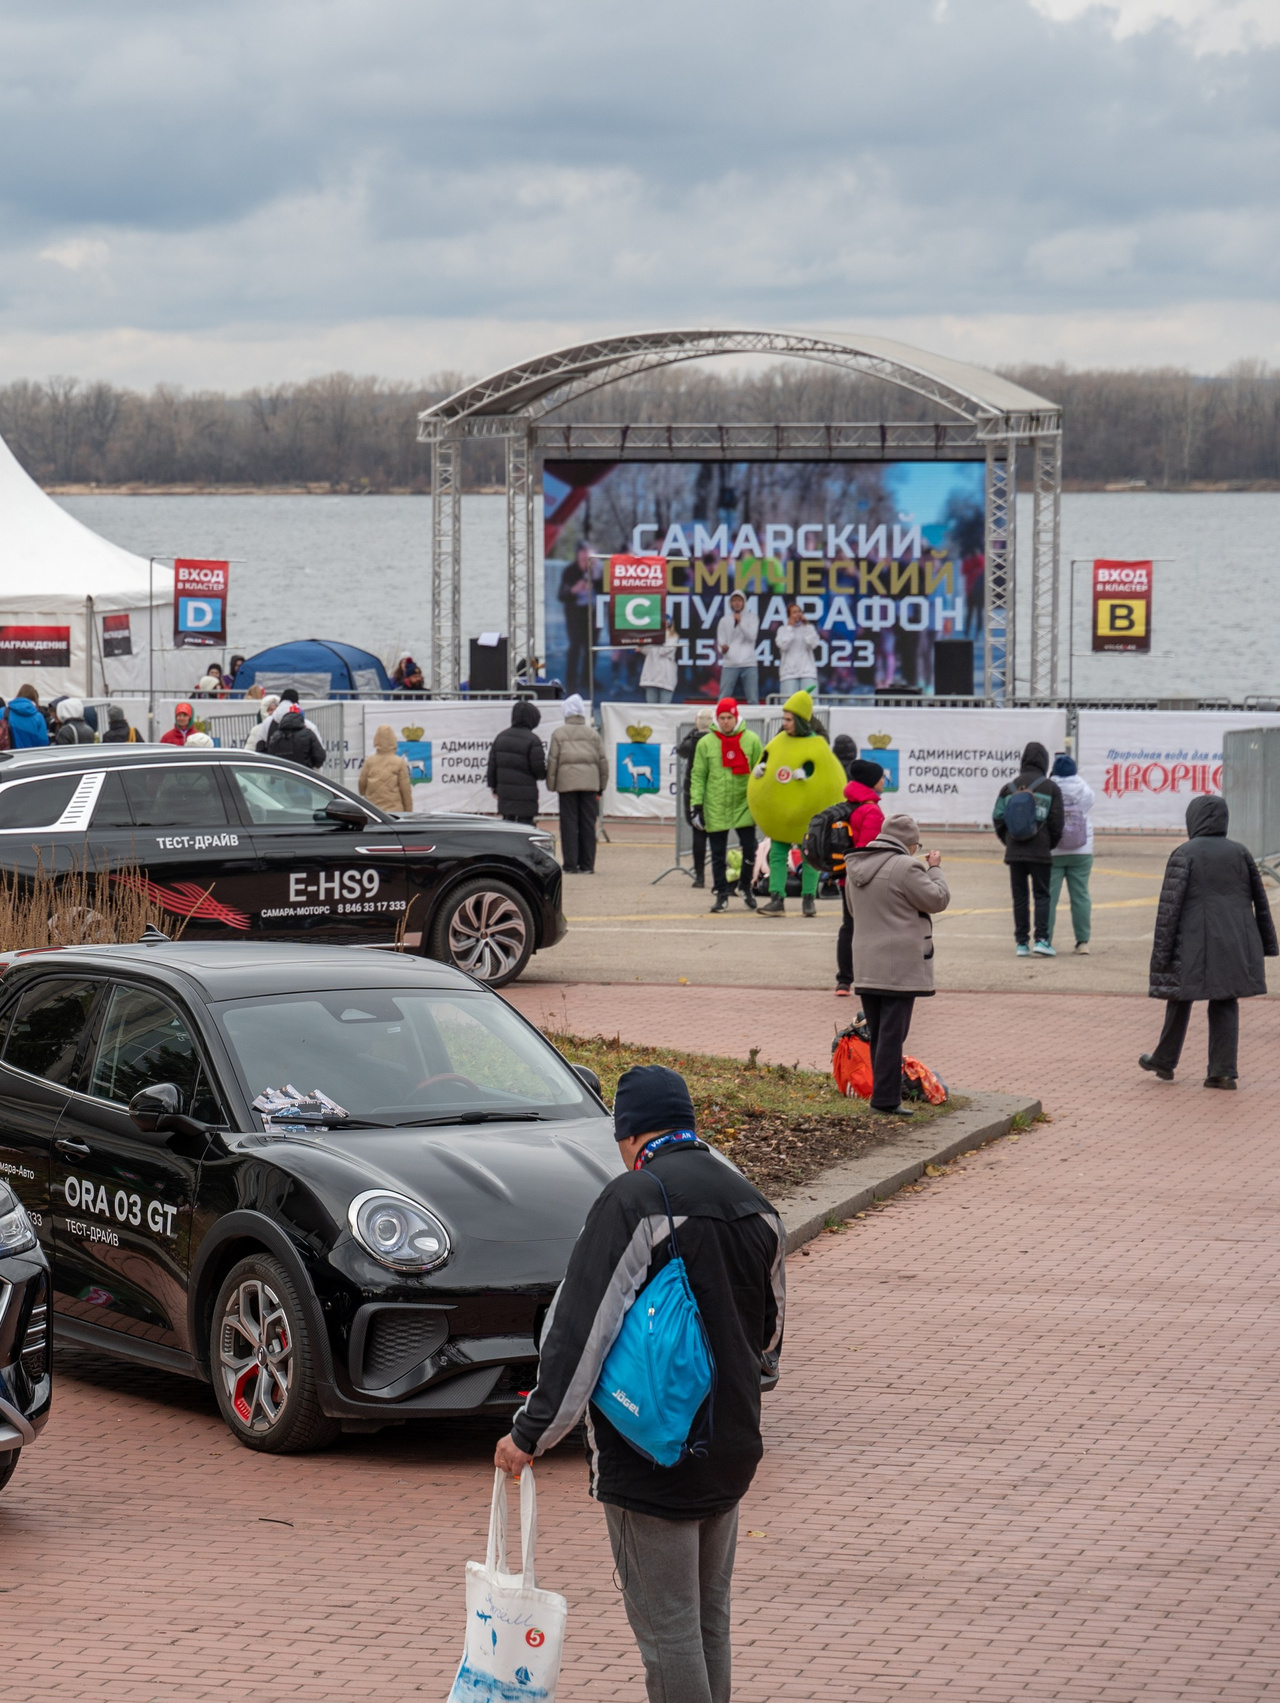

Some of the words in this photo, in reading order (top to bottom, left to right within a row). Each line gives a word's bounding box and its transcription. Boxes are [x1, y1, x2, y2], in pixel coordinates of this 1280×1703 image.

[633, 513, 921, 558] САМАРСКИЙ
[179, 568, 224, 583] ВХОД
[603, 550, 954, 595] СМИЧЕСКИЙ
[614, 565, 662, 579] ВХОД
[1098, 568, 1147, 583] ВХОД
[185, 582, 224, 591] КЛАСТЕР
[622, 579, 663, 587] КЛАСТЕР
[1105, 583, 1148, 592] КЛАСТЕР
[187, 601, 213, 627] D
[625, 598, 651, 626] C
[1109, 604, 1135, 631] B
[908, 749, 1020, 761] АДМИНИСТРАЦИЯ
[1106, 749, 1161, 761] Природная
[1164, 750, 1188, 760] вода
[1191, 750, 1208, 760] для
[908, 766, 988, 778] ГОРОДСКОГО
[908, 783, 959, 794] САМАРА
[156, 833, 239, 850] ТЕСТ-ДРАЙВ
[289, 869, 380, 902] E-HS9
[261, 906, 330, 917] САМАРА-МОТОРС
[337, 904, 344, 913] 8
[345, 903, 362, 913] 846
[363, 902, 375, 912] 33
[376, 902, 388, 911] 17
[389, 901, 406, 911] 333
[651, 1132, 692, 1148] VOLAMAN
[65, 1176, 110, 1217] ORA
[114, 1190, 142, 1226] 03
[147, 1200, 177, 1237] GT
[65, 1219, 119, 1247] ТЕСТ-ДРАЙВ
